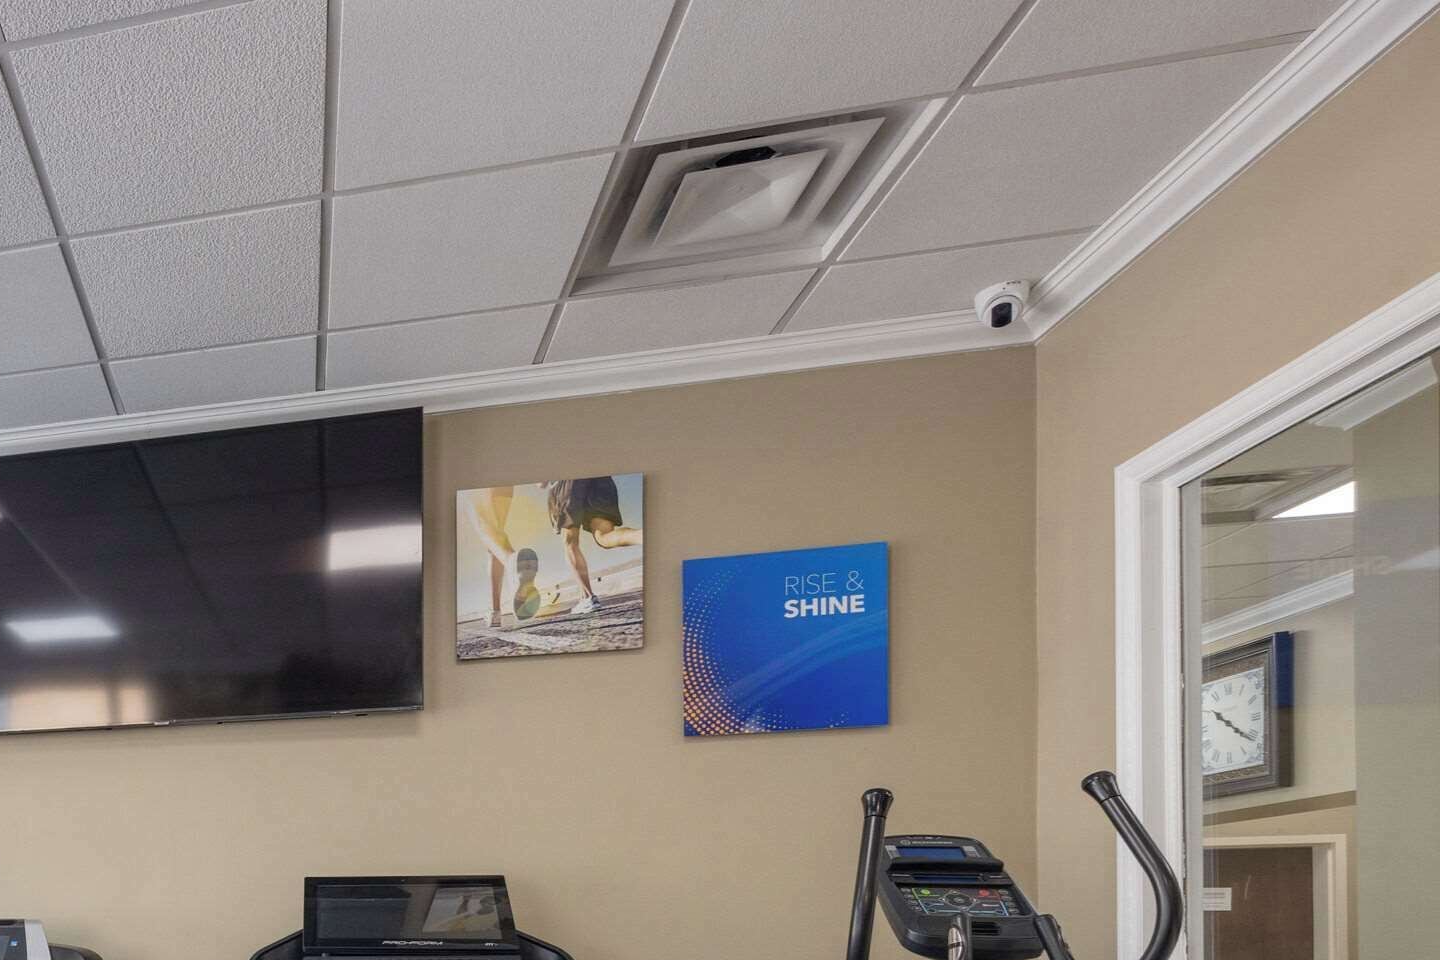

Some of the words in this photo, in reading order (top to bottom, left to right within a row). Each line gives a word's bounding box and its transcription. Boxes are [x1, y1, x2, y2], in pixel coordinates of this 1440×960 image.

[785, 572, 837, 596] RISE
[846, 569, 865, 592] &
[784, 594, 866, 618] SHINE
